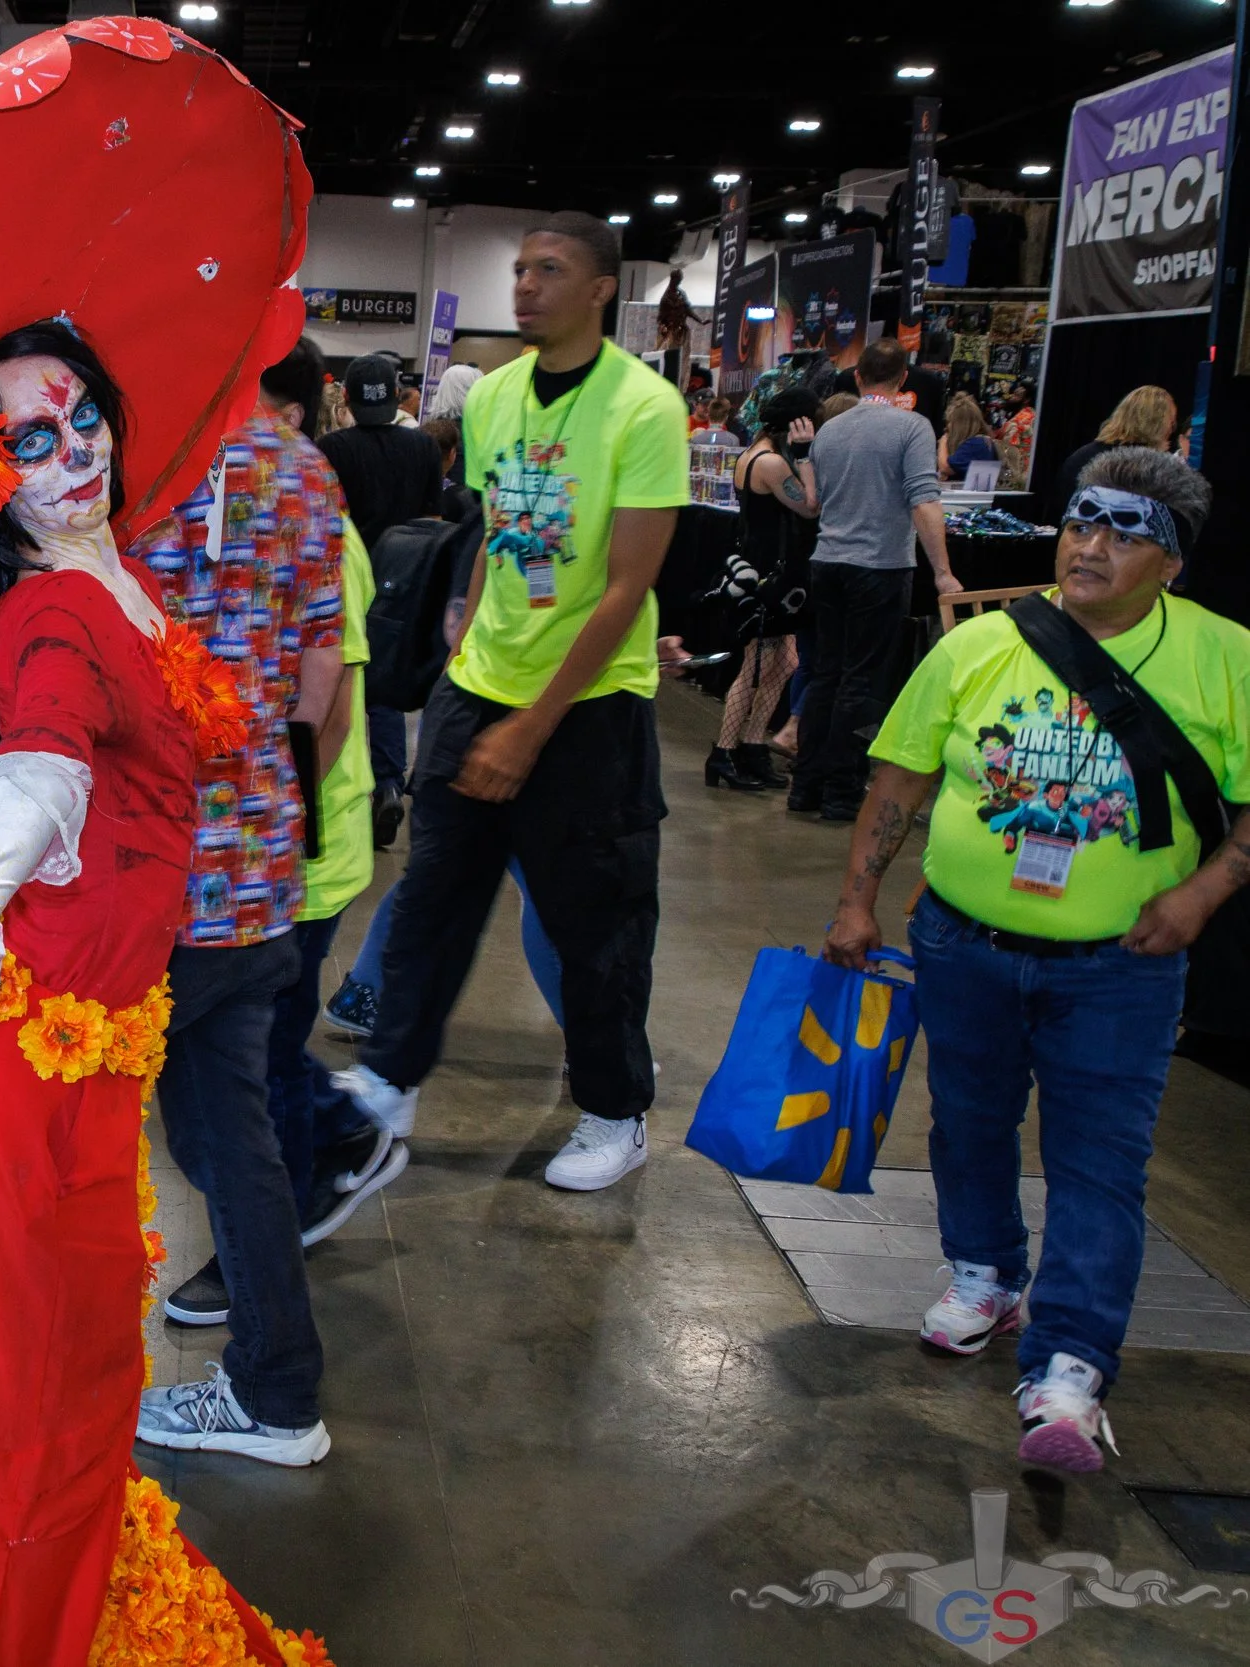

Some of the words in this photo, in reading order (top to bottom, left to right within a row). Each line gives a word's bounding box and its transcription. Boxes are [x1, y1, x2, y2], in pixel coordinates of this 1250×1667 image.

[1106, 108, 1167, 162] FAN
[1167, 87, 1231, 146] EXP
[1066, 149, 1225, 248] MERCH
[912, 156, 930, 315] FUDGE
[341, 298, 414, 316] BURGERS
[1011, 751, 1123, 787] FANDOM
[1014, 727, 1096, 757] UNITED
